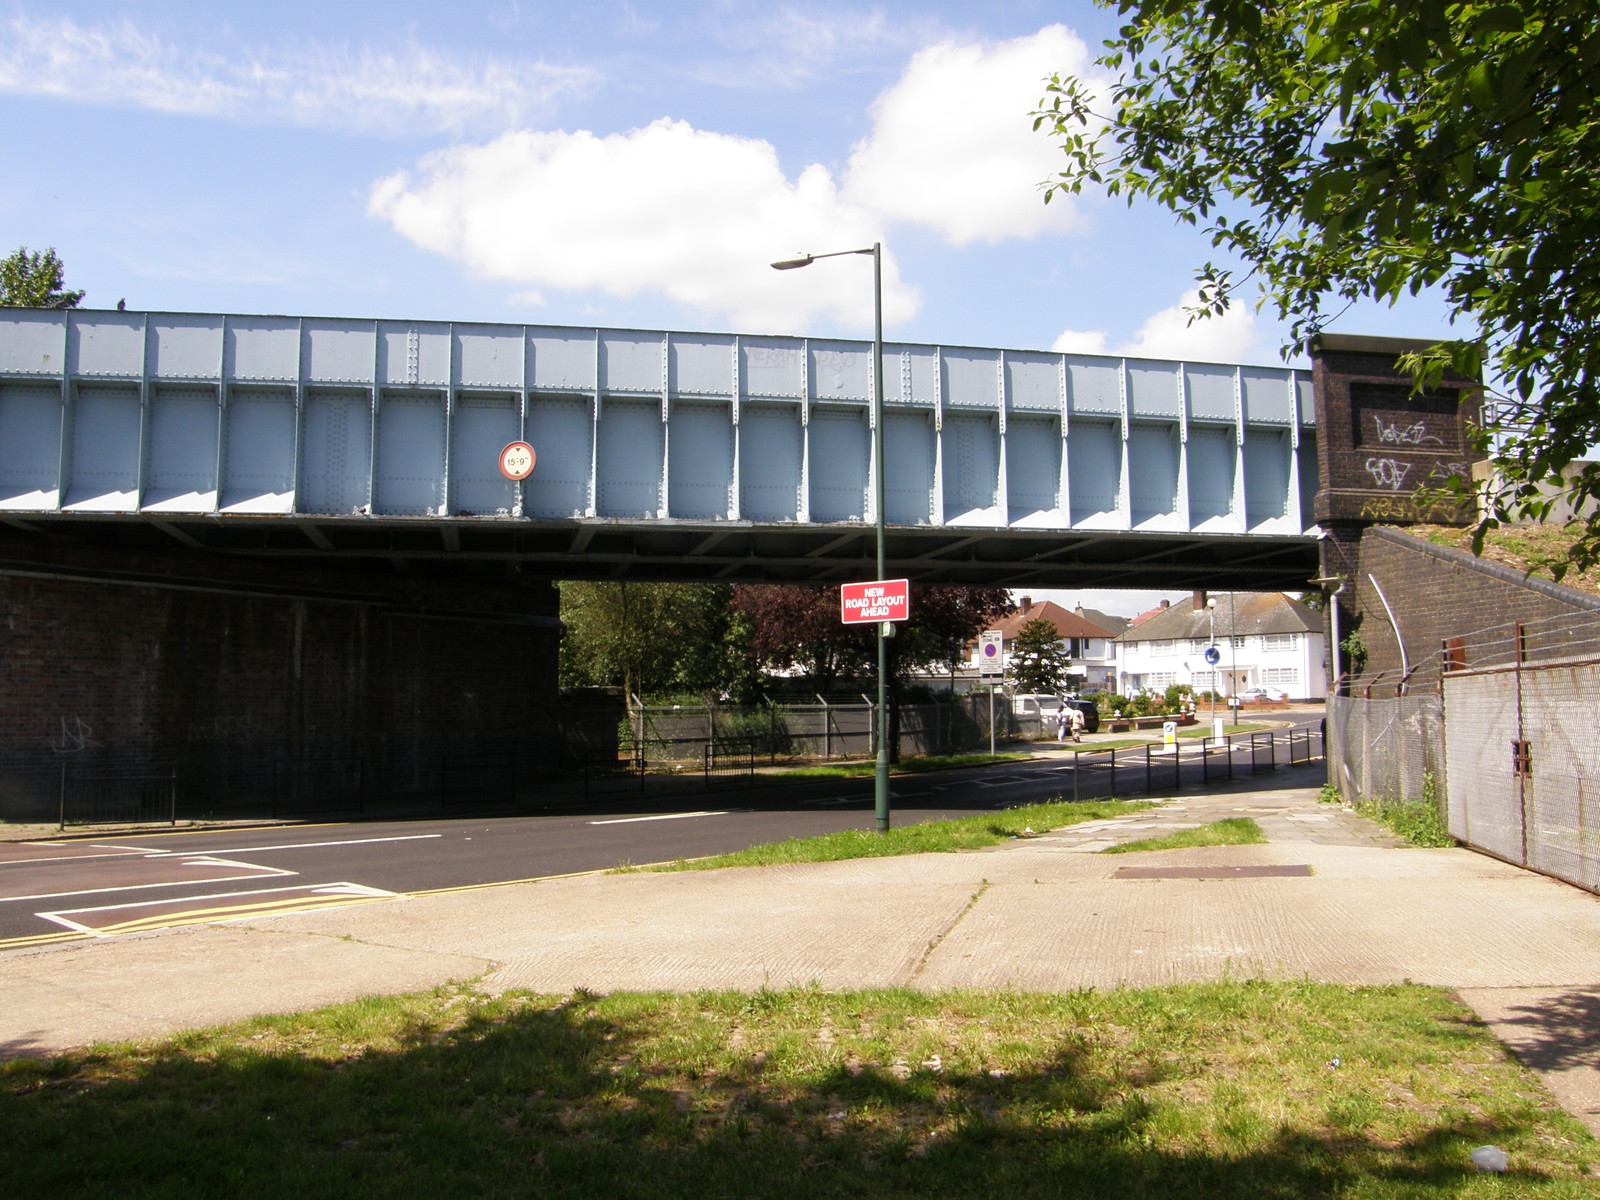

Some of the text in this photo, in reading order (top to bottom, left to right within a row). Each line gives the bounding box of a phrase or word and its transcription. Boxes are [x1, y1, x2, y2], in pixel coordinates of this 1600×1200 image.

[864, 587, 884, 598] NEW
[845, 595, 905, 609] ROAD LAYOUT
[860, 606, 890, 617] AHEAD
